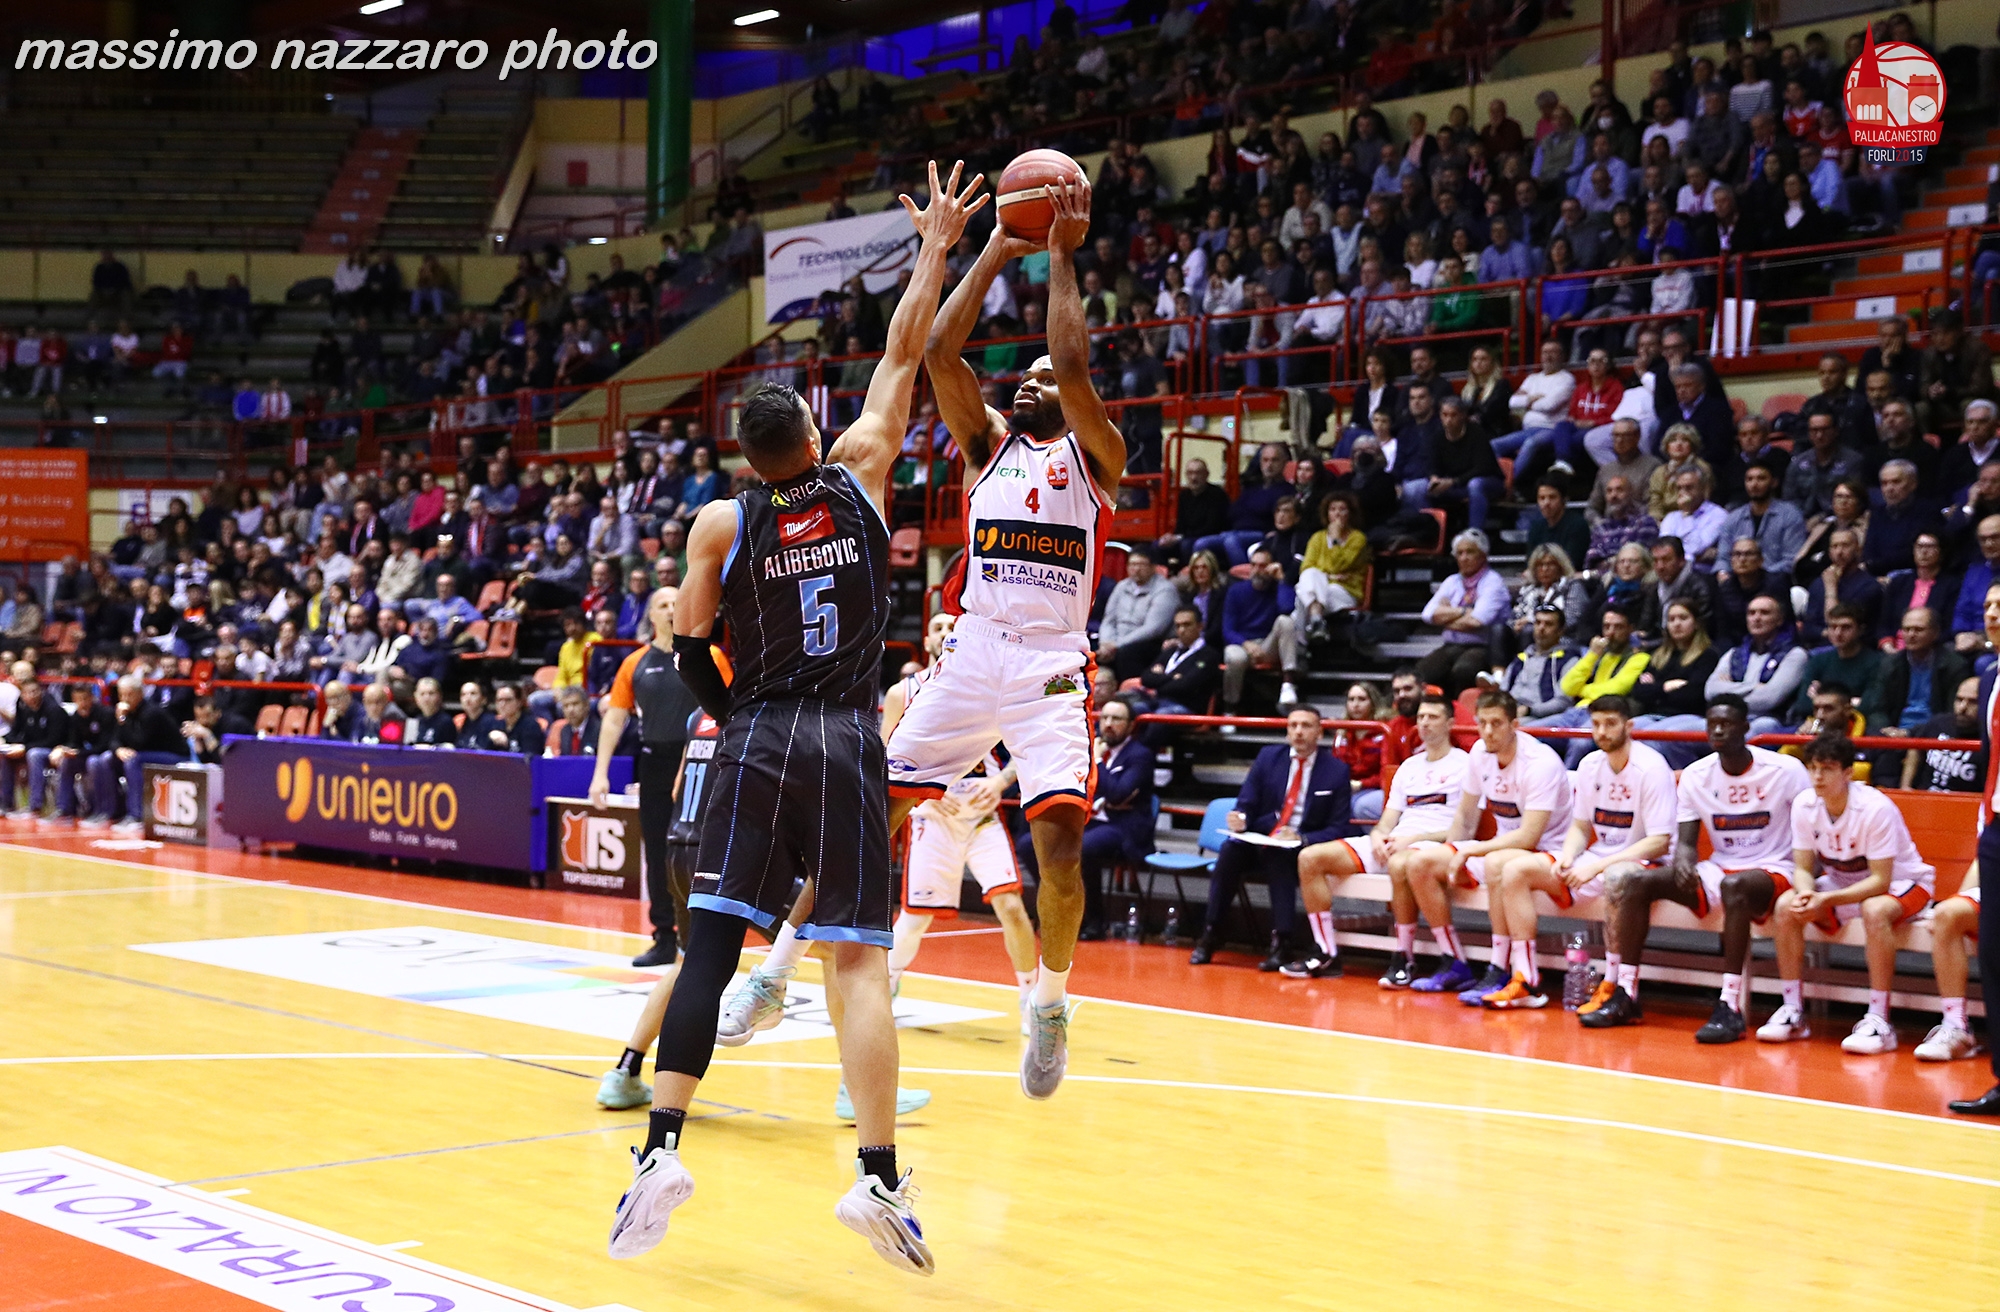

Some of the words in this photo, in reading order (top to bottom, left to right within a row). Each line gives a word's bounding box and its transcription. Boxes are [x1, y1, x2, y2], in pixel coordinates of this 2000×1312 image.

[1025, 487, 1040, 514] 4
[764, 537, 859, 580] ALIBEGOVIC
[1001, 530, 1085, 560] unieuro
[1002, 564, 1077, 588] ITALIANA
[1002, 576, 1077, 597] ASSICURAZIONI
[798, 574, 838, 657] 5
[317, 761, 458, 832] unieuro
[680, 762, 707, 823] 11
[1728, 785, 1749, 803] 22
[917, 827, 925, 841] 7
